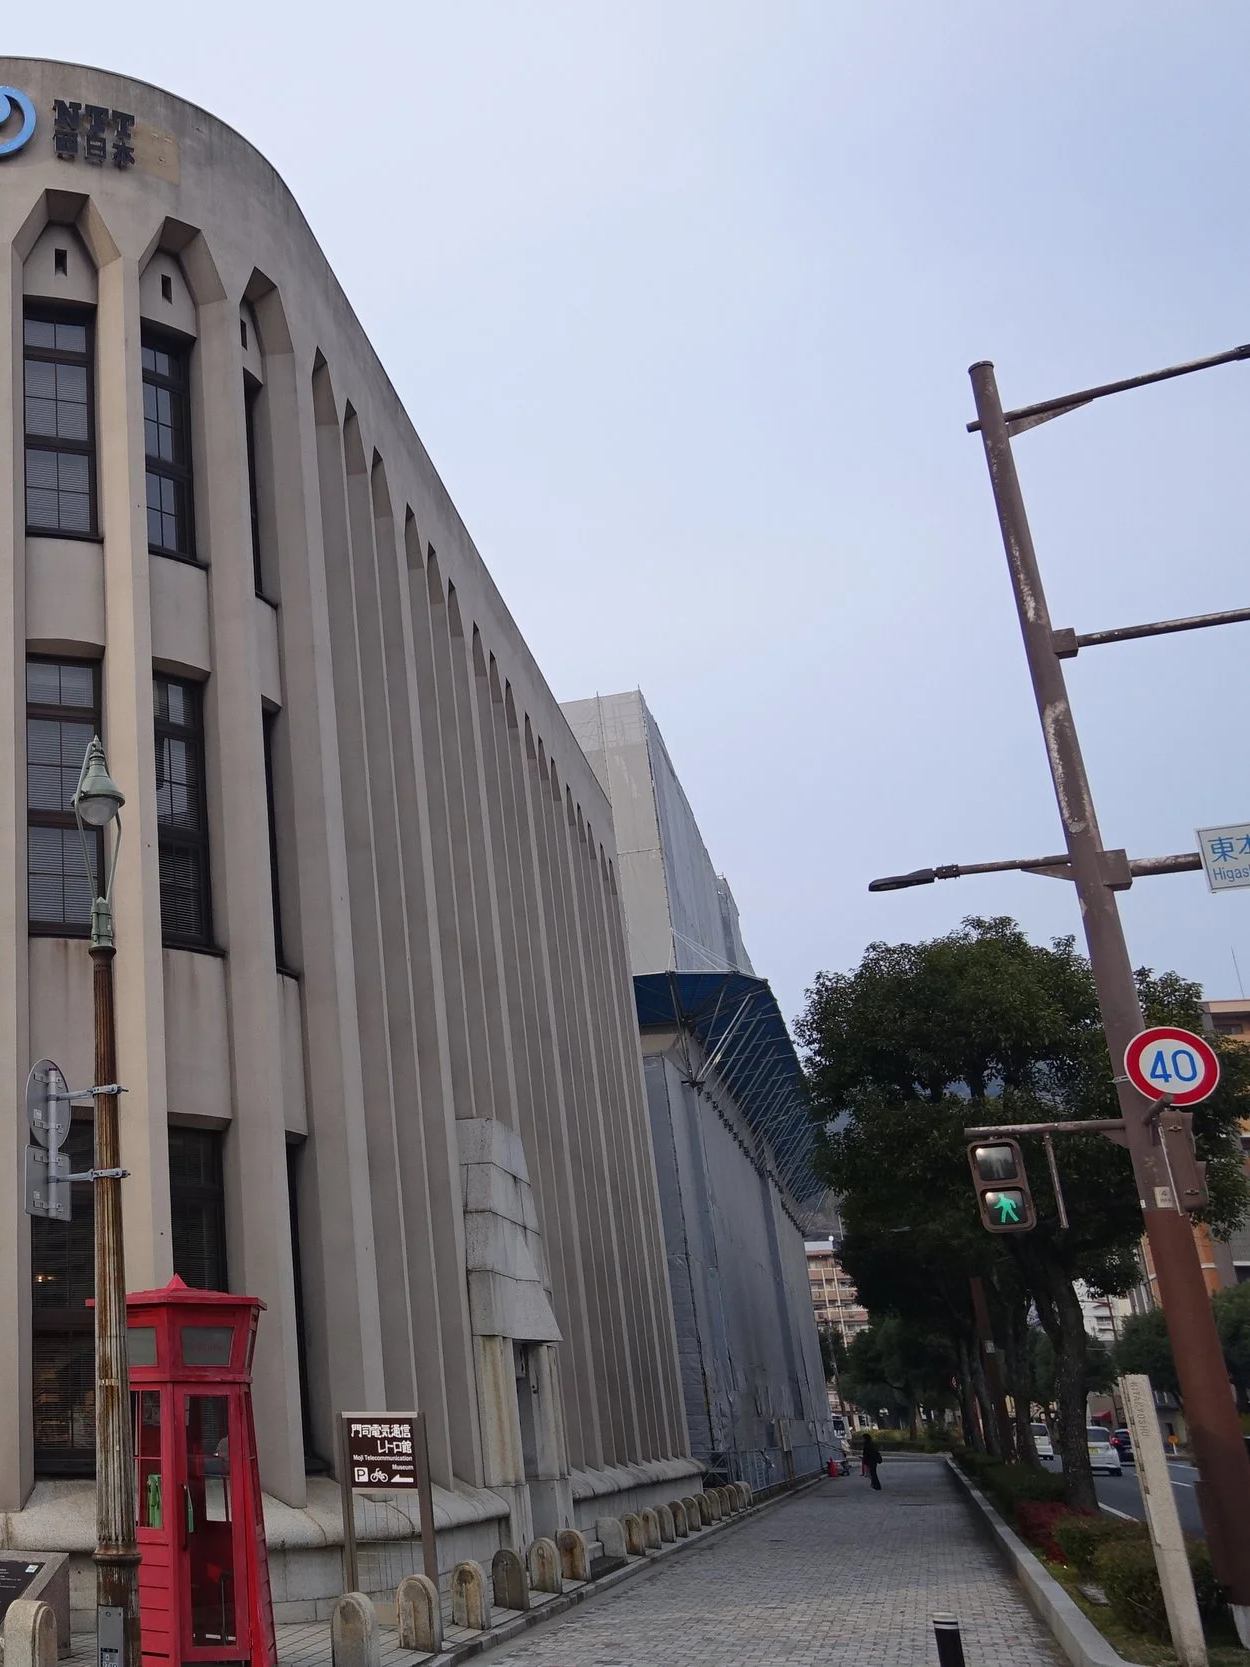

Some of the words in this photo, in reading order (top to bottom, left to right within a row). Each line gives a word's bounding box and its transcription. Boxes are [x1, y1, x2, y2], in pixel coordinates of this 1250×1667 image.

[53, 99, 135, 140] NTT
[53, 131, 135, 170] 西日本
[1150, 1049, 1198, 1083] 40
[351, 1424, 411, 1438] 門司電気通信
[377, 1440, 412, 1453] レトロ館
